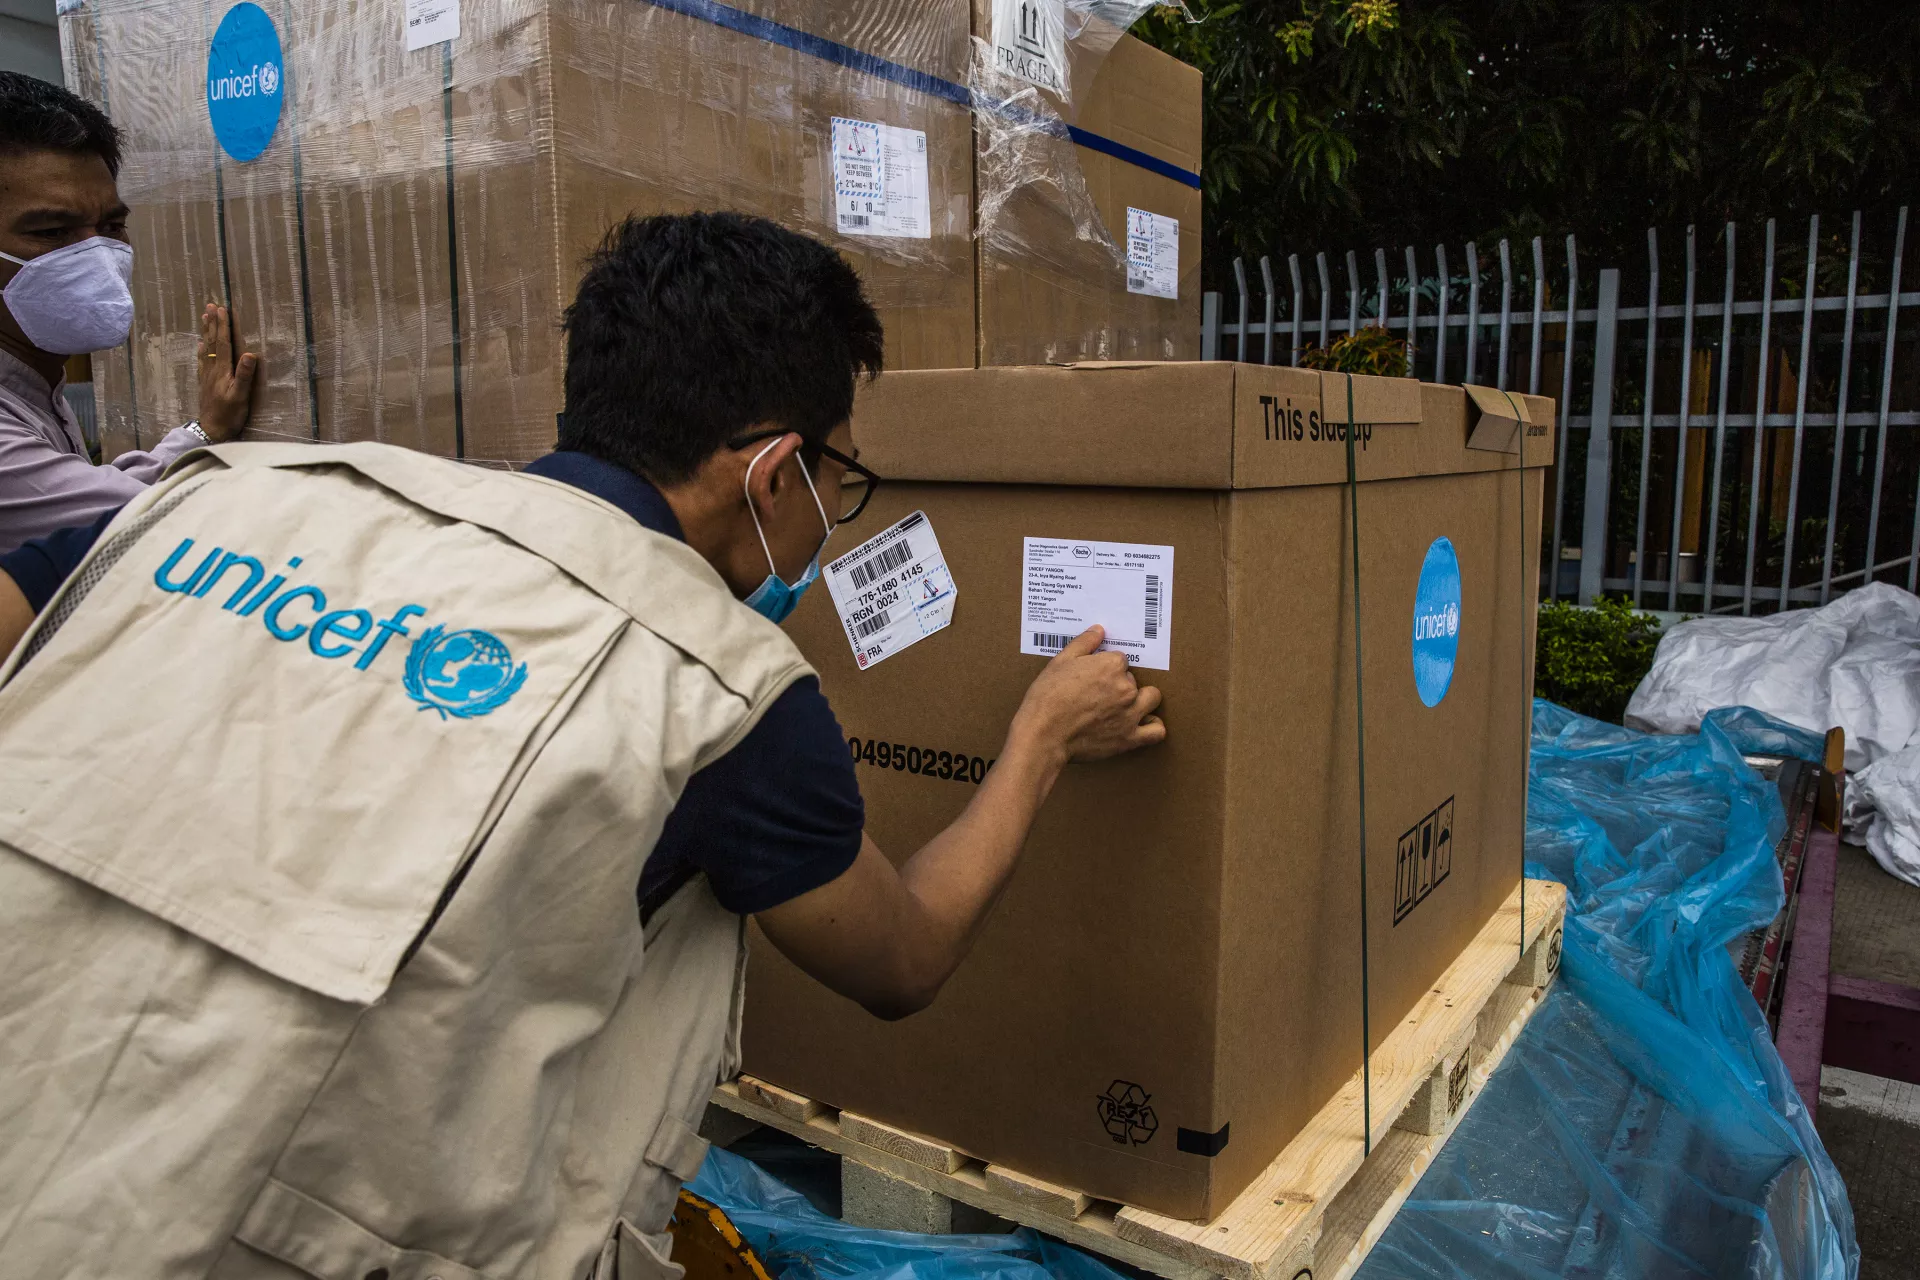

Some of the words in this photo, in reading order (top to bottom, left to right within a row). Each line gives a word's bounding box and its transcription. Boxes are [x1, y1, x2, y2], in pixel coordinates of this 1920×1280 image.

[210, 64, 258, 100] unicef
[1259, 395, 1304, 441] This
[858, 577, 898, 606] 176-1480
[901, 562, 923, 582] 4145
[154, 538, 427, 671] unicef
[852, 604, 875, 623] RGN
[876, 591, 899, 610] 0024
[1415, 604, 1447, 641] unicef
[867, 644, 883, 659] FRA
